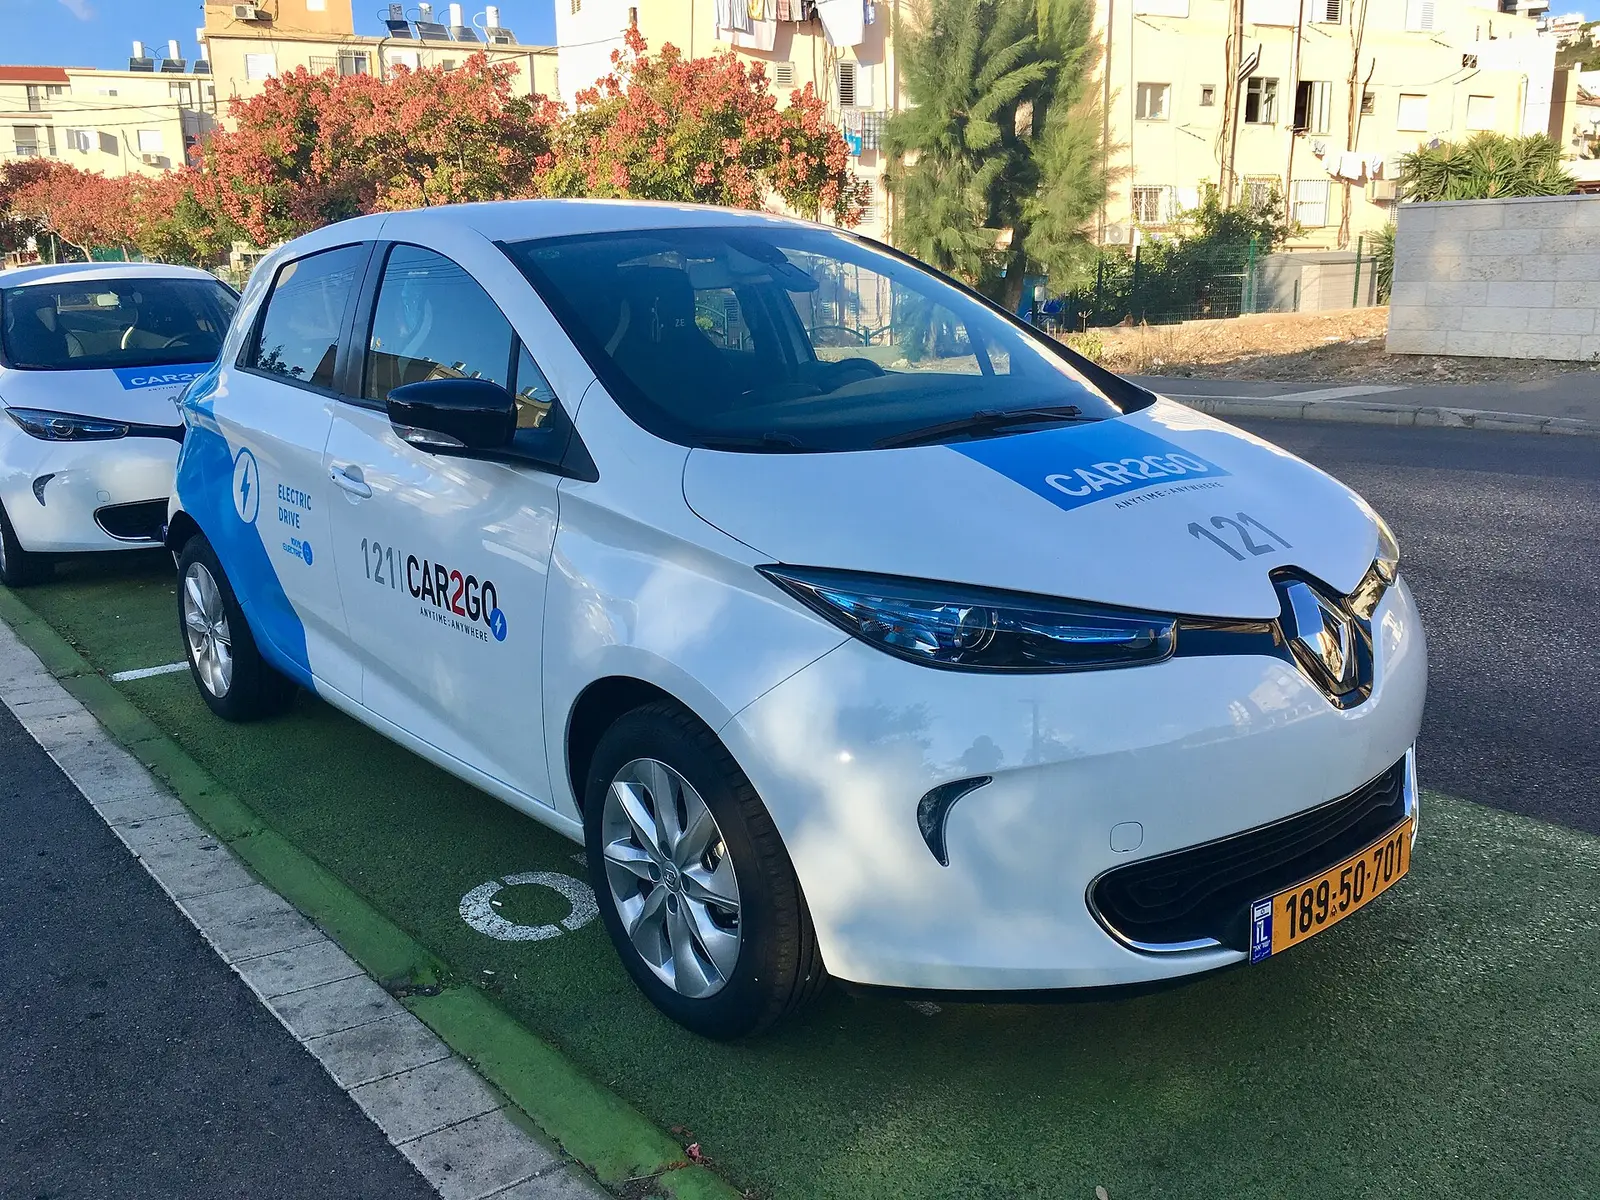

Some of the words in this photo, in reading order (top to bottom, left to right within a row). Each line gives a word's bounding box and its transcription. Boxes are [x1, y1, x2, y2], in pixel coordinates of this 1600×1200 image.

[1045, 453, 1209, 497] CAR2GO
[278, 483, 312, 511] ELECTRIC
[278, 506, 301, 529] DRIVE
[1187, 512, 1293, 562] 121
[406, 554, 498, 628] CAR2GO
[1256, 919, 1268, 944] IL
